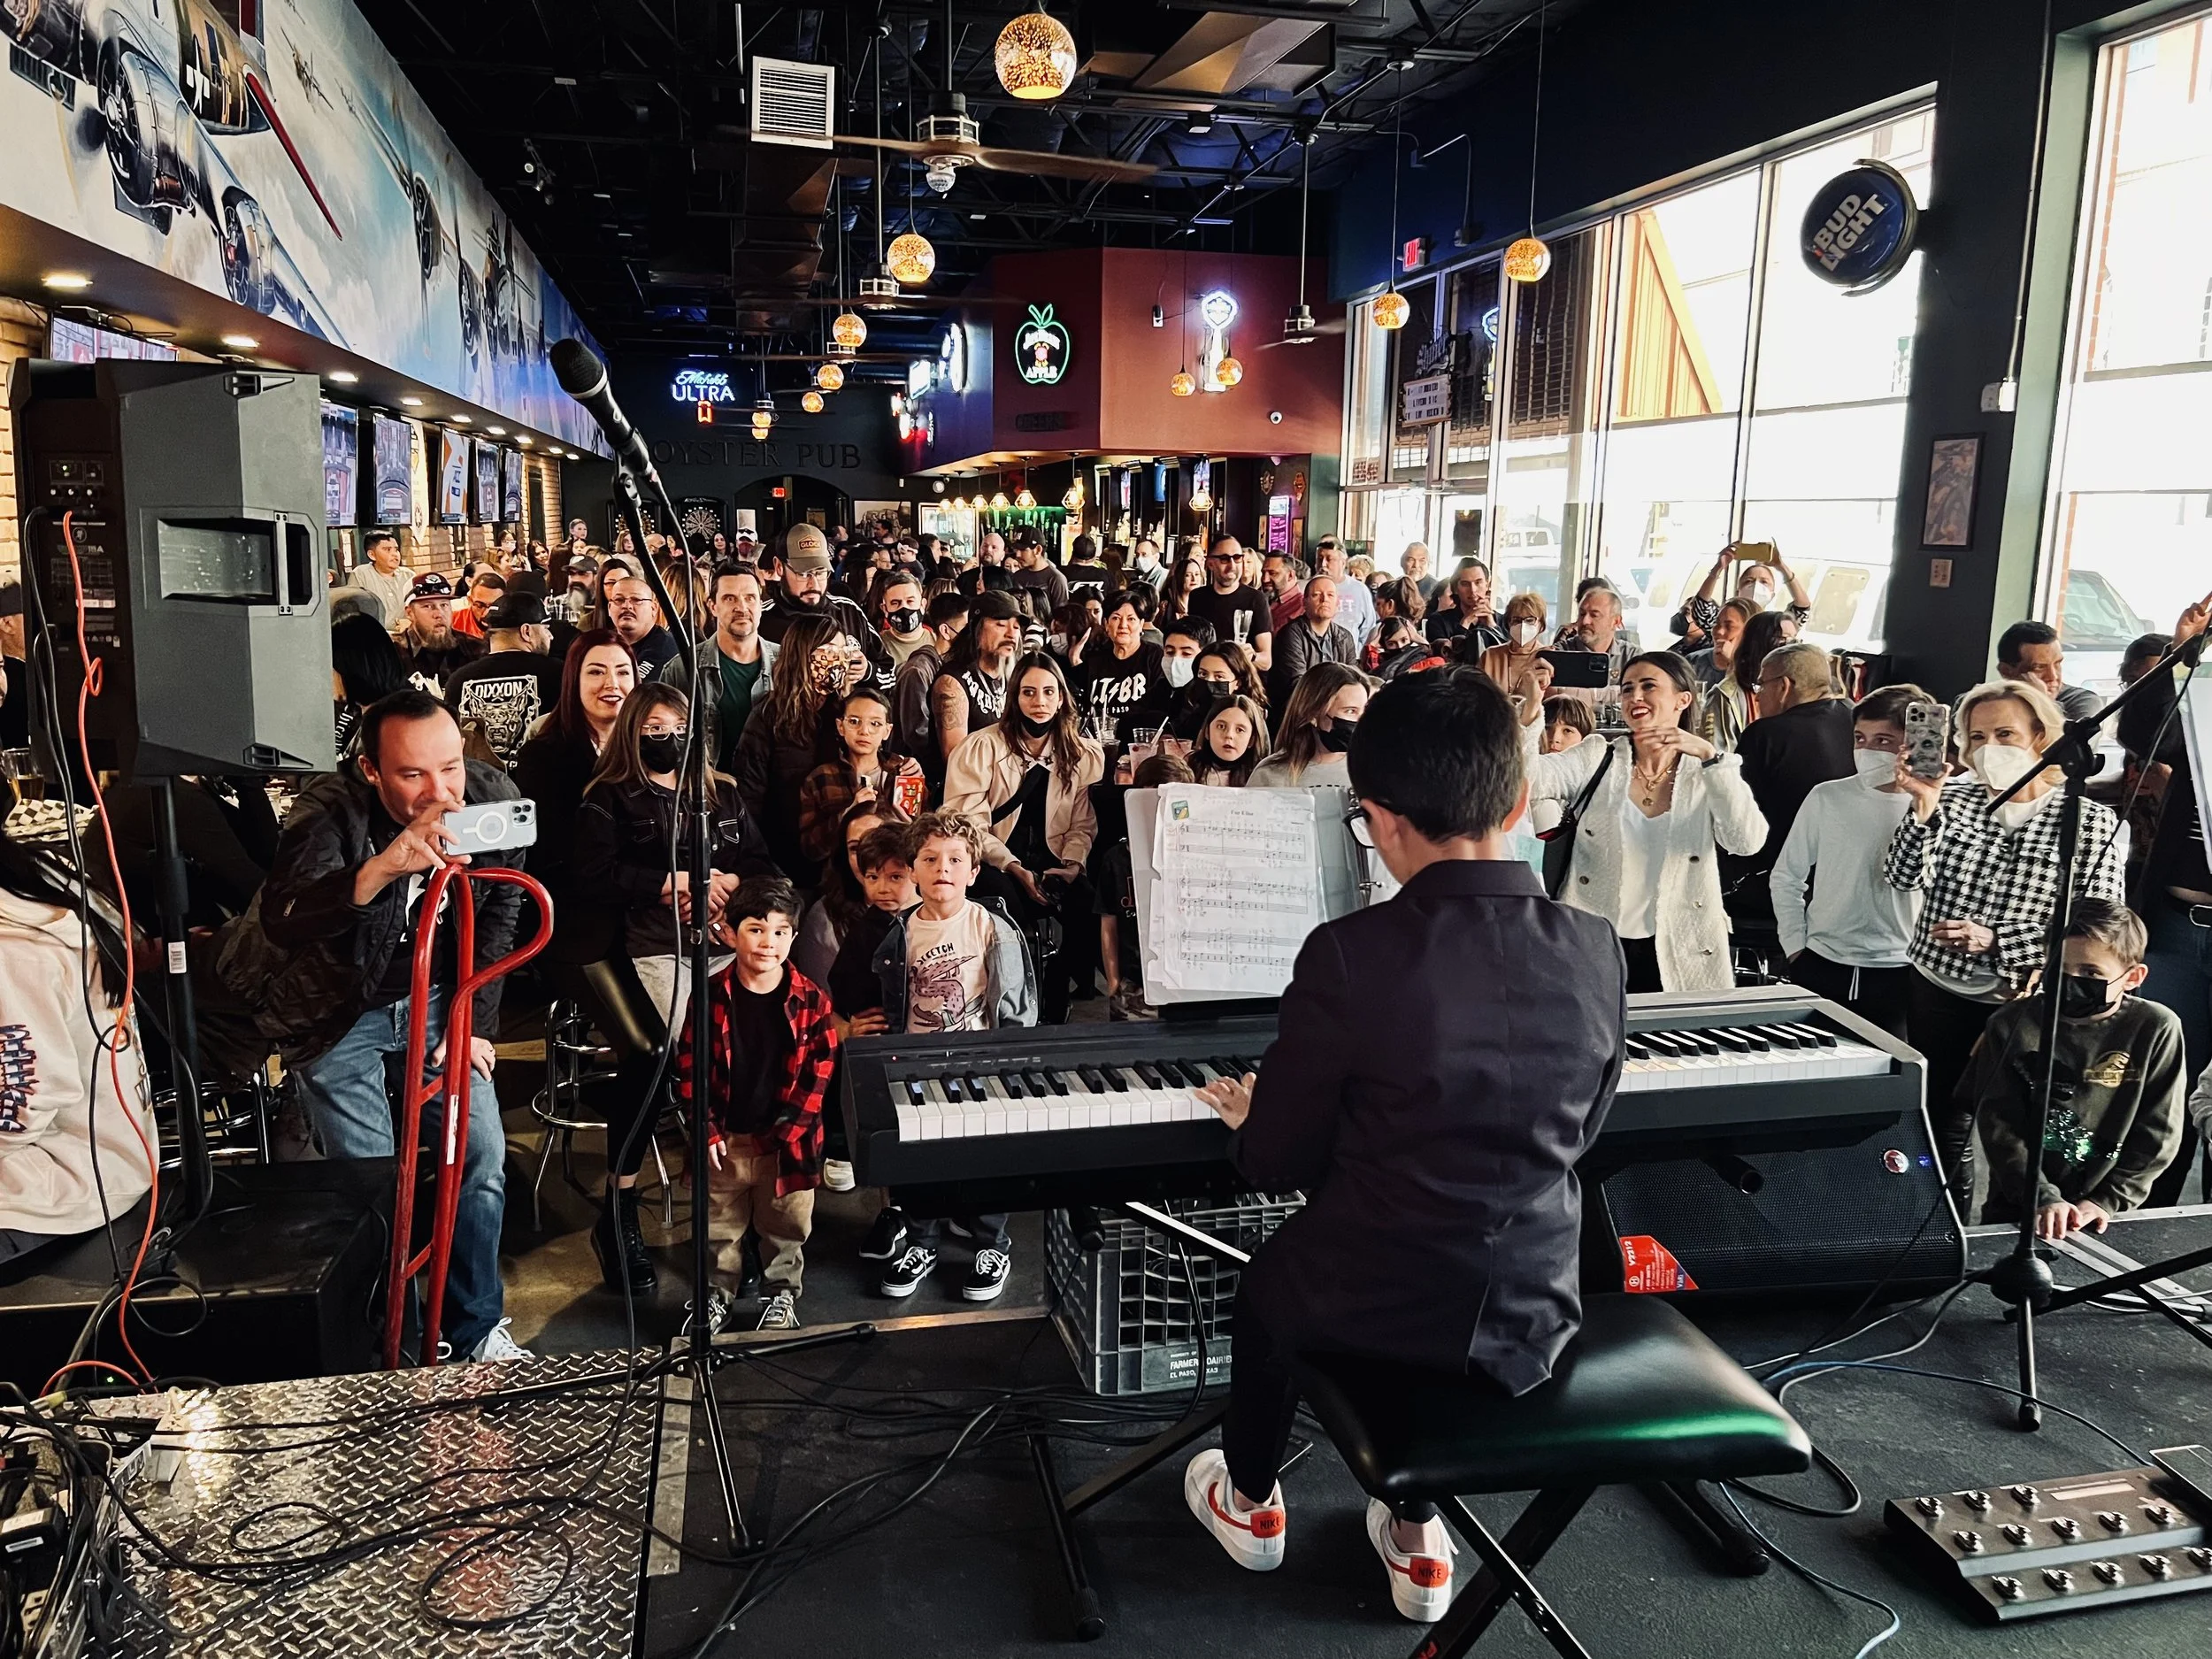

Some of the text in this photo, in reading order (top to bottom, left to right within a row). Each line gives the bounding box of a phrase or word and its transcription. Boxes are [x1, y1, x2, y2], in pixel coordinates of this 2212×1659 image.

[1813, 194, 1861, 250] BUD
[1819, 193, 1886, 272] LIGHT
[672, 384, 735, 402] ULTRA
[651, 439, 862, 470] OYSTER PUB
[475, 680, 523, 698] DIXXON
[1624, 1240, 1636, 1266] V2212
[1170, 1358, 1199, 1371] FARMER
[1259, 1517, 1281, 1530] NIKE
[1417, 1566, 1442, 1579] NIKE
